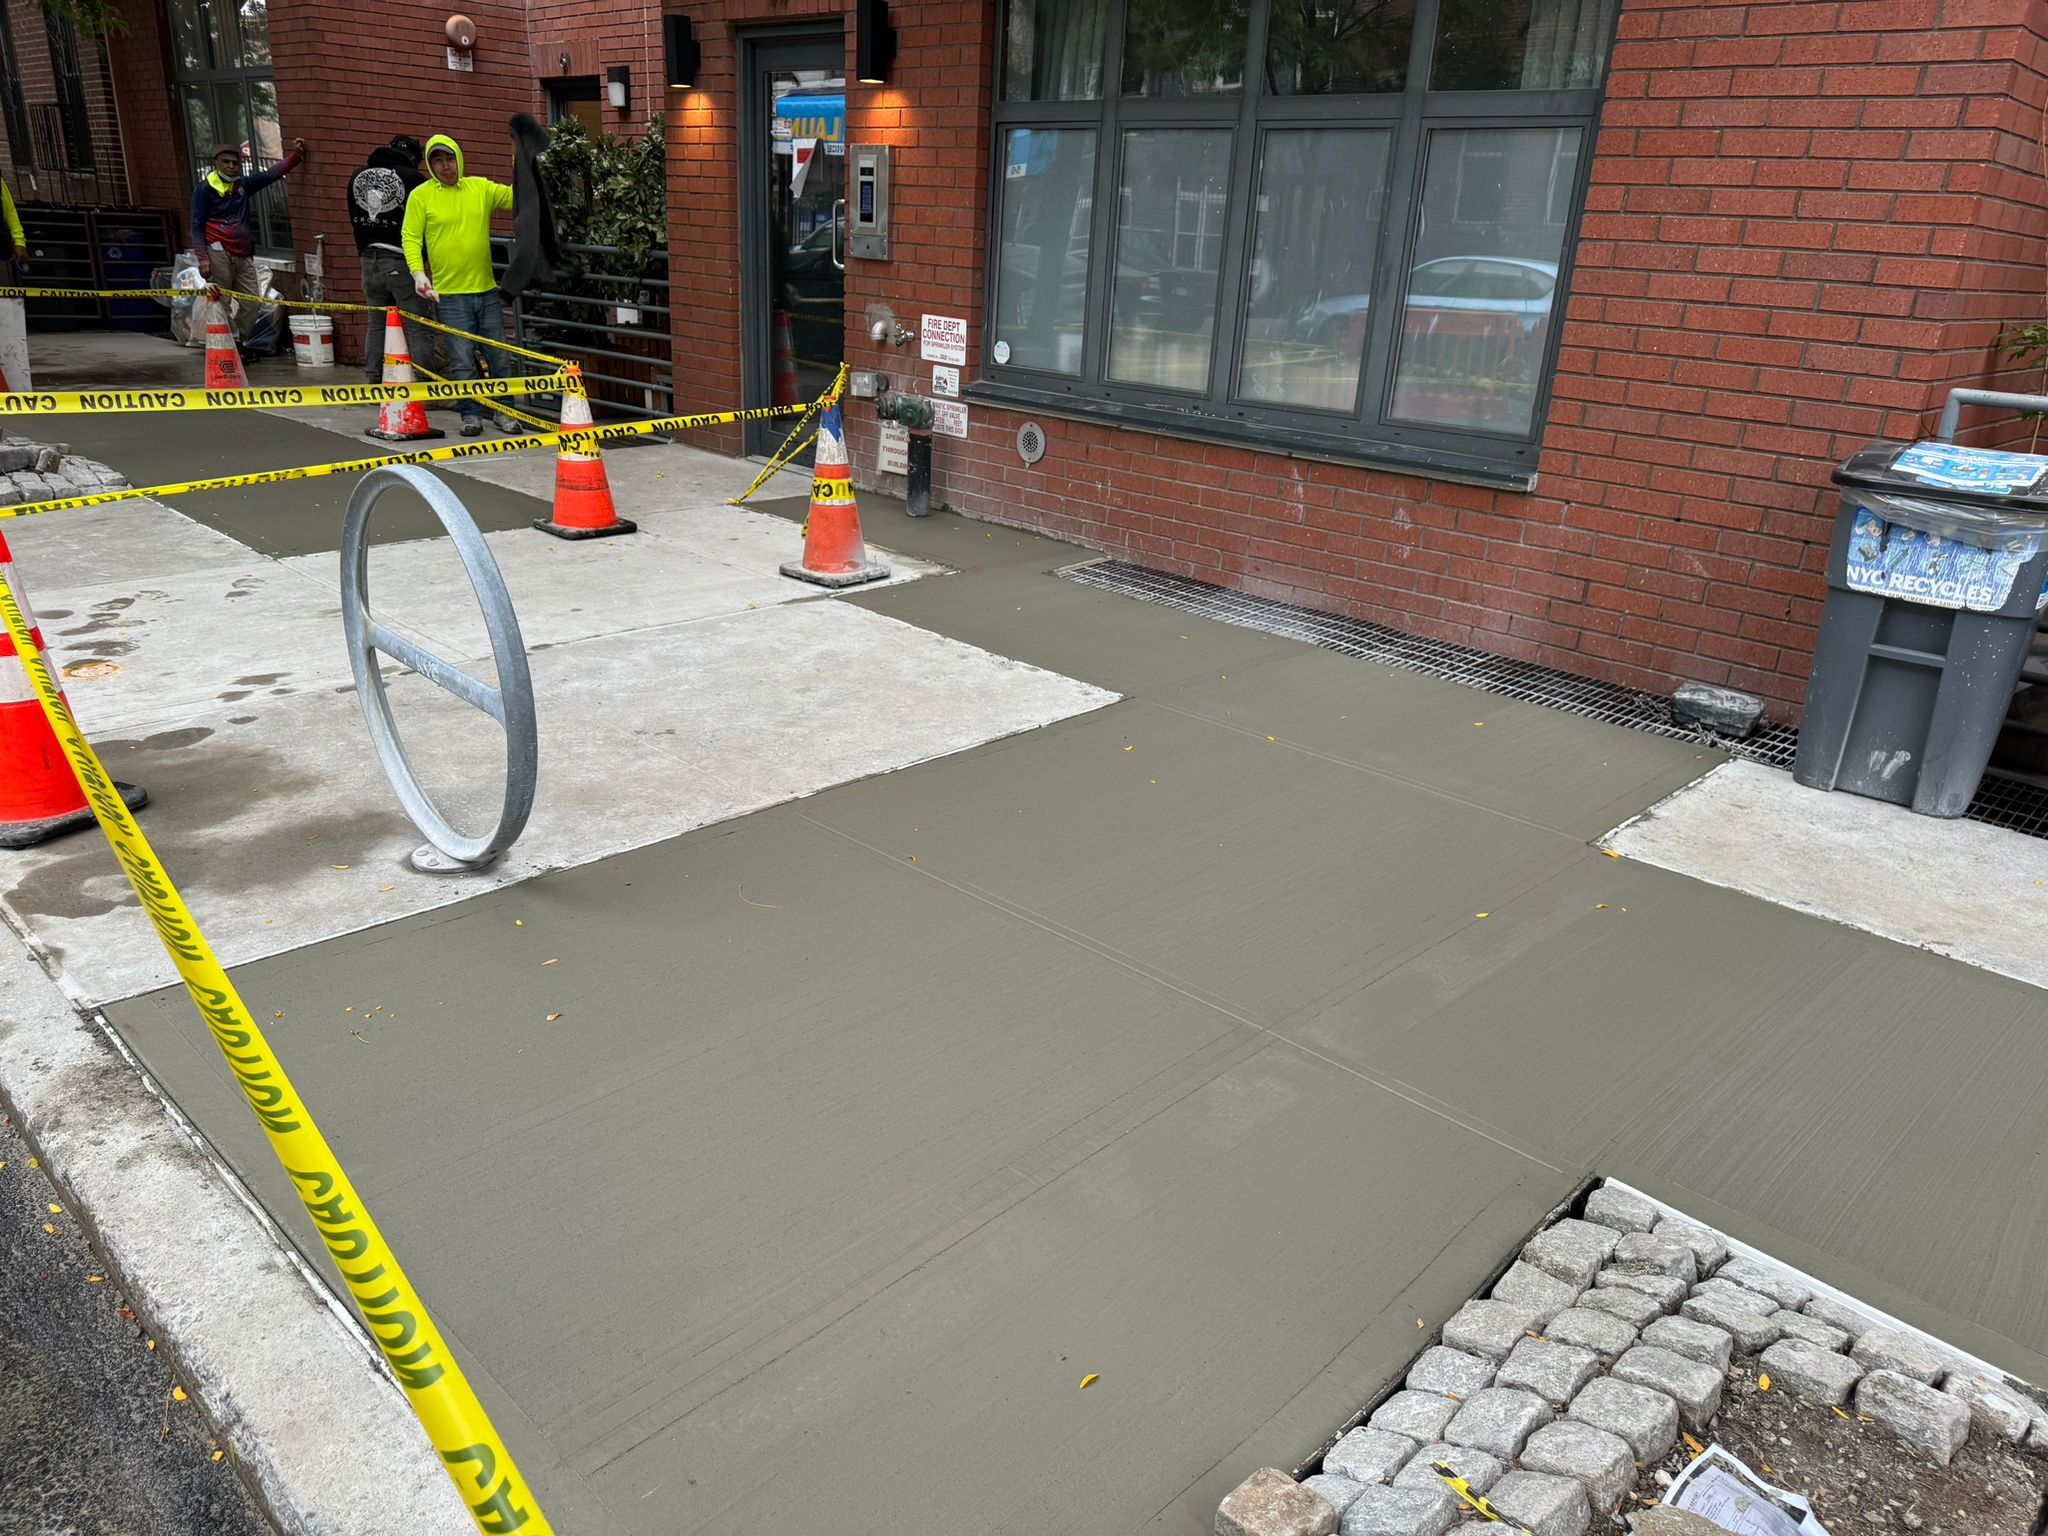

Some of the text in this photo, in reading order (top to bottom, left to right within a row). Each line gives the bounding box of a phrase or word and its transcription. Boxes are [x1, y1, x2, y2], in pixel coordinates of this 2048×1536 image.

[928, 318, 960, 332] FIRE DEPT
[923, 328, 965, 344] CONNECTION
[205, 389, 303, 407] CAUTION
[321, 385, 410, 403] CAUTION
[427, 380, 509, 398] CAUTION
[0, 394, 57, 411] CAU
[79, 391, 186, 411] CAUTION
[1847, 564, 1994, 601] NYC RECYCLES
